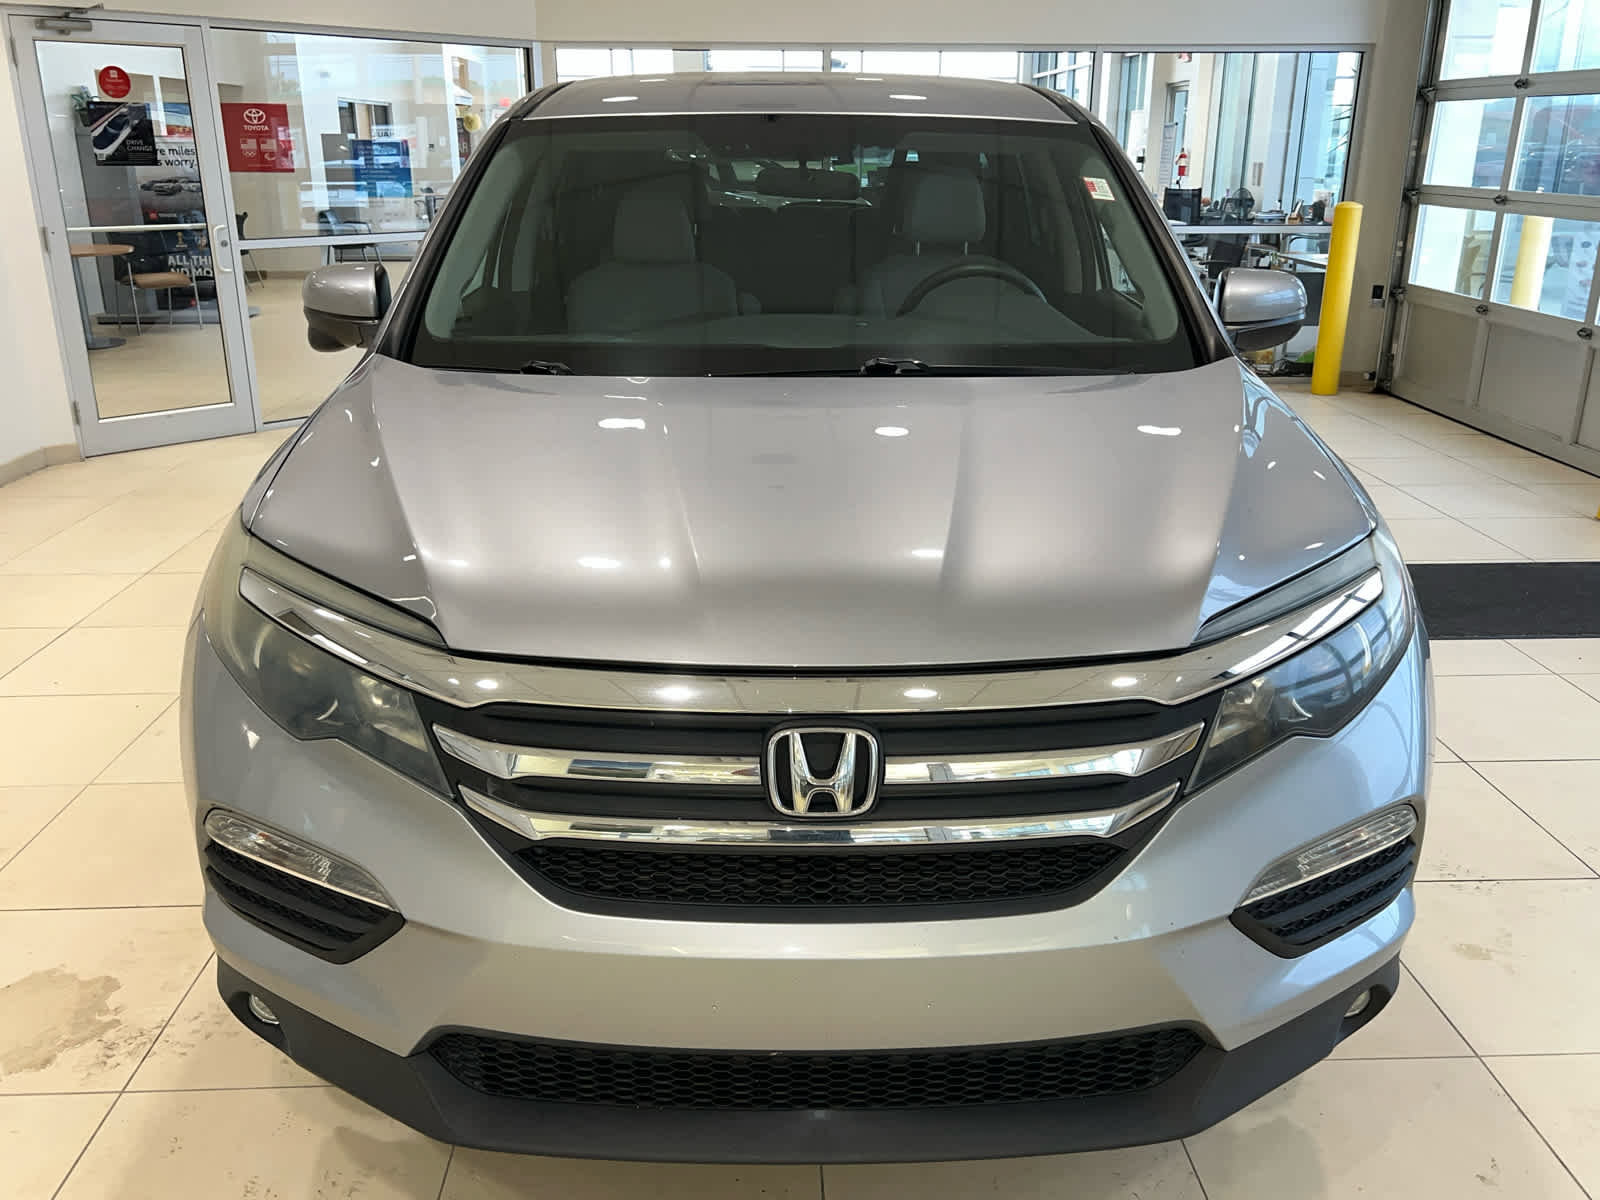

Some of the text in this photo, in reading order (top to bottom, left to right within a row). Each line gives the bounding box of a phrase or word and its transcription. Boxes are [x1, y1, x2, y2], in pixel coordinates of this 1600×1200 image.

[168, 145, 196, 156] miles
[165, 159, 197, 168] worry.
[168, 255, 190, 266] ALL
